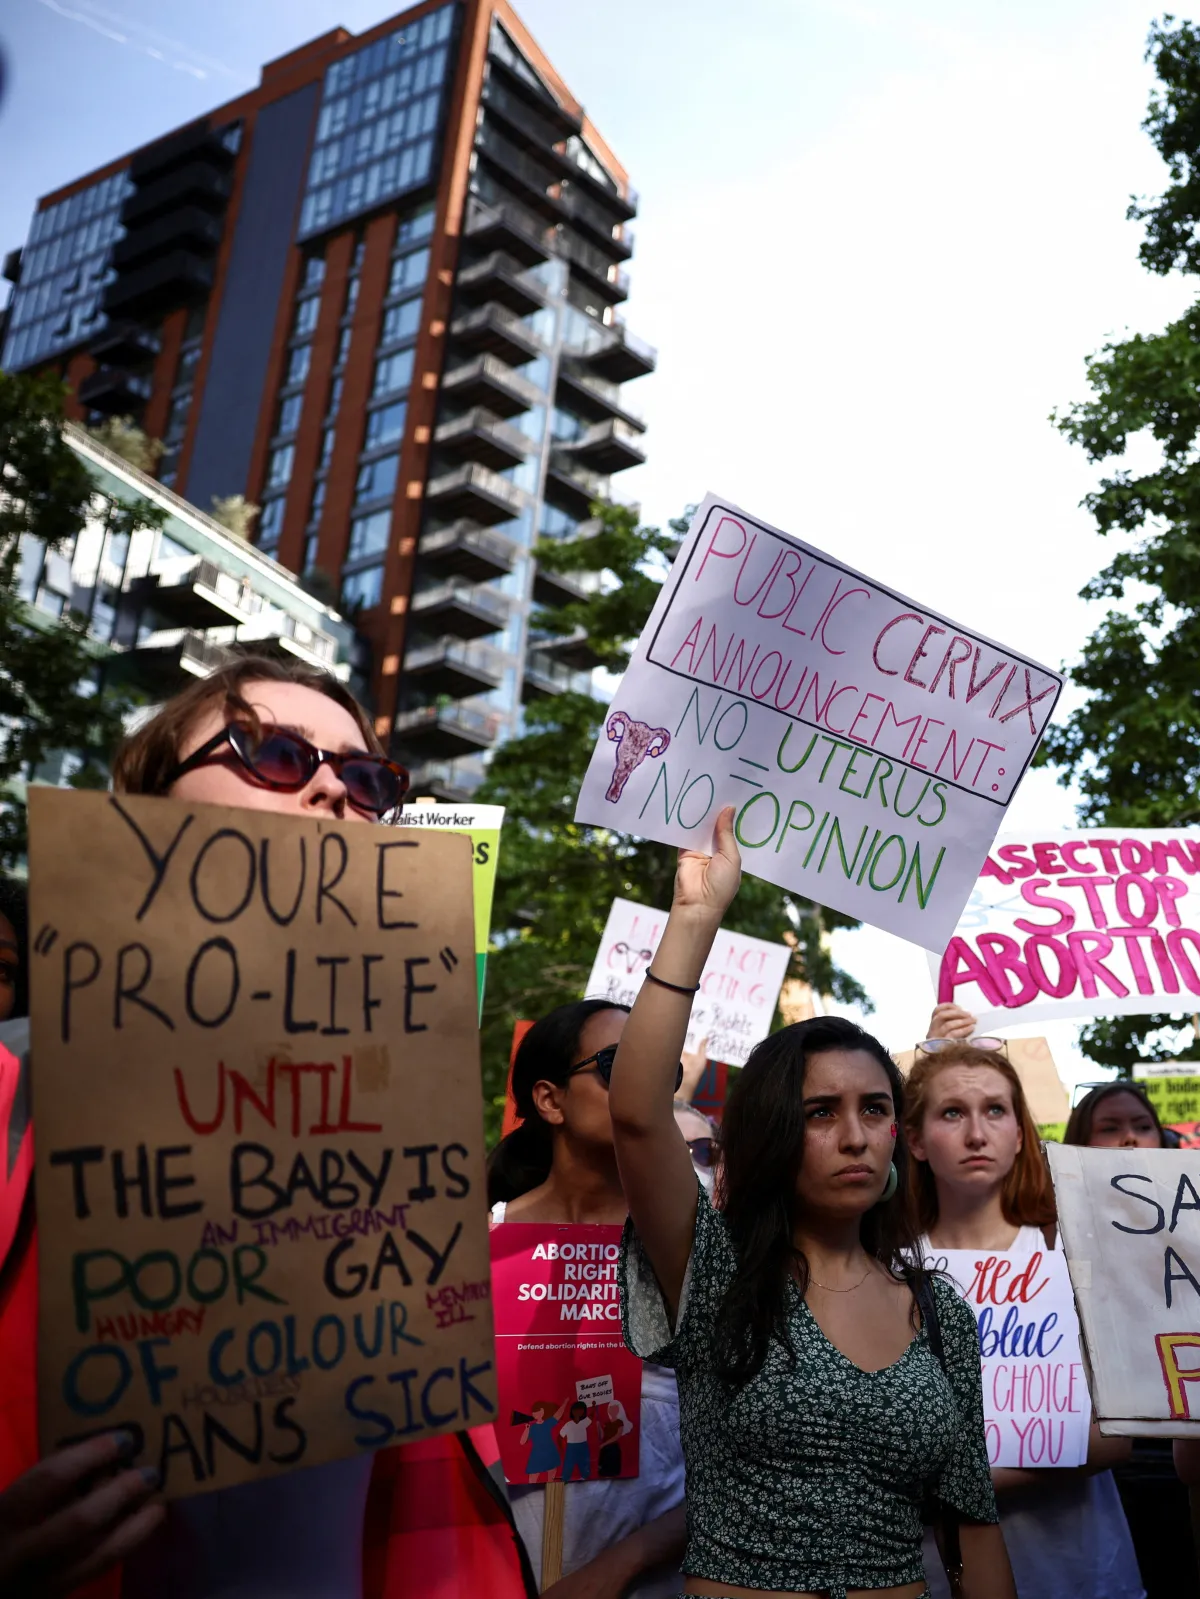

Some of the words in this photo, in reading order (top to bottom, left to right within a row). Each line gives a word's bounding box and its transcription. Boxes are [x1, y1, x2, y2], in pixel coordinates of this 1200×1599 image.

[695, 517, 870, 655] PUBLIC
[873, 614, 1056, 735] CERVIX
[670, 616, 1006, 792] ANNOUNCEMENT:
[675, 686, 748, 750] NO
[776, 722, 947, 827] UTERUS
[426, 812, 475, 826] Worker
[639, 762, 715, 829] NO
[735, 791, 946, 910] OPINION
[1013, 873, 1188, 936] STOP
[33, 924, 459, 1043] "PRO-LIFE"
[174, 1055, 383, 1138] UNTIL
[50, 1143, 204, 1221] THE
[230, 1142, 394, 1219] BABY
[403, 1143, 470, 1202] IS
[201, 1221, 238, 1248] AN
[251, 1203, 412, 1247] IMMIGRANT
[531, 1243, 619, 1261] ABORTIO
[71, 1244, 290, 1333] POOR
[323, 1222, 463, 1299] GAY
[517, 1283, 619, 1302] SOLIDARIT
[564, 1263, 618, 1281] RIGHT
[963, 1251, 1050, 1305] red
[95, 1306, 207, 1342] HUNGRY
[434, 1304, 475, 1329] ILL
[560, 1303, 623, 1322] MARC
[978, 1305, 1064, 1358] blue
[63, 1338, 179, 1416] OF
[208, 1302, 425, 1387] COLOUR
[517, 1343, 544, 1351] Defend
[545, 1342, 576, 1350] abortion
[576, 1341, 597, 1351] rights
[599, 1341, 605, 1349] in
[606, 1341, 618, 1349] the
[344, 1358, 496, 1448] SICK
[591, 1388, 613, 1399] BODIES
[993, 1363, 1082, 1413] CHOICE
[1010, 1416, 1064, 1467] YOU
